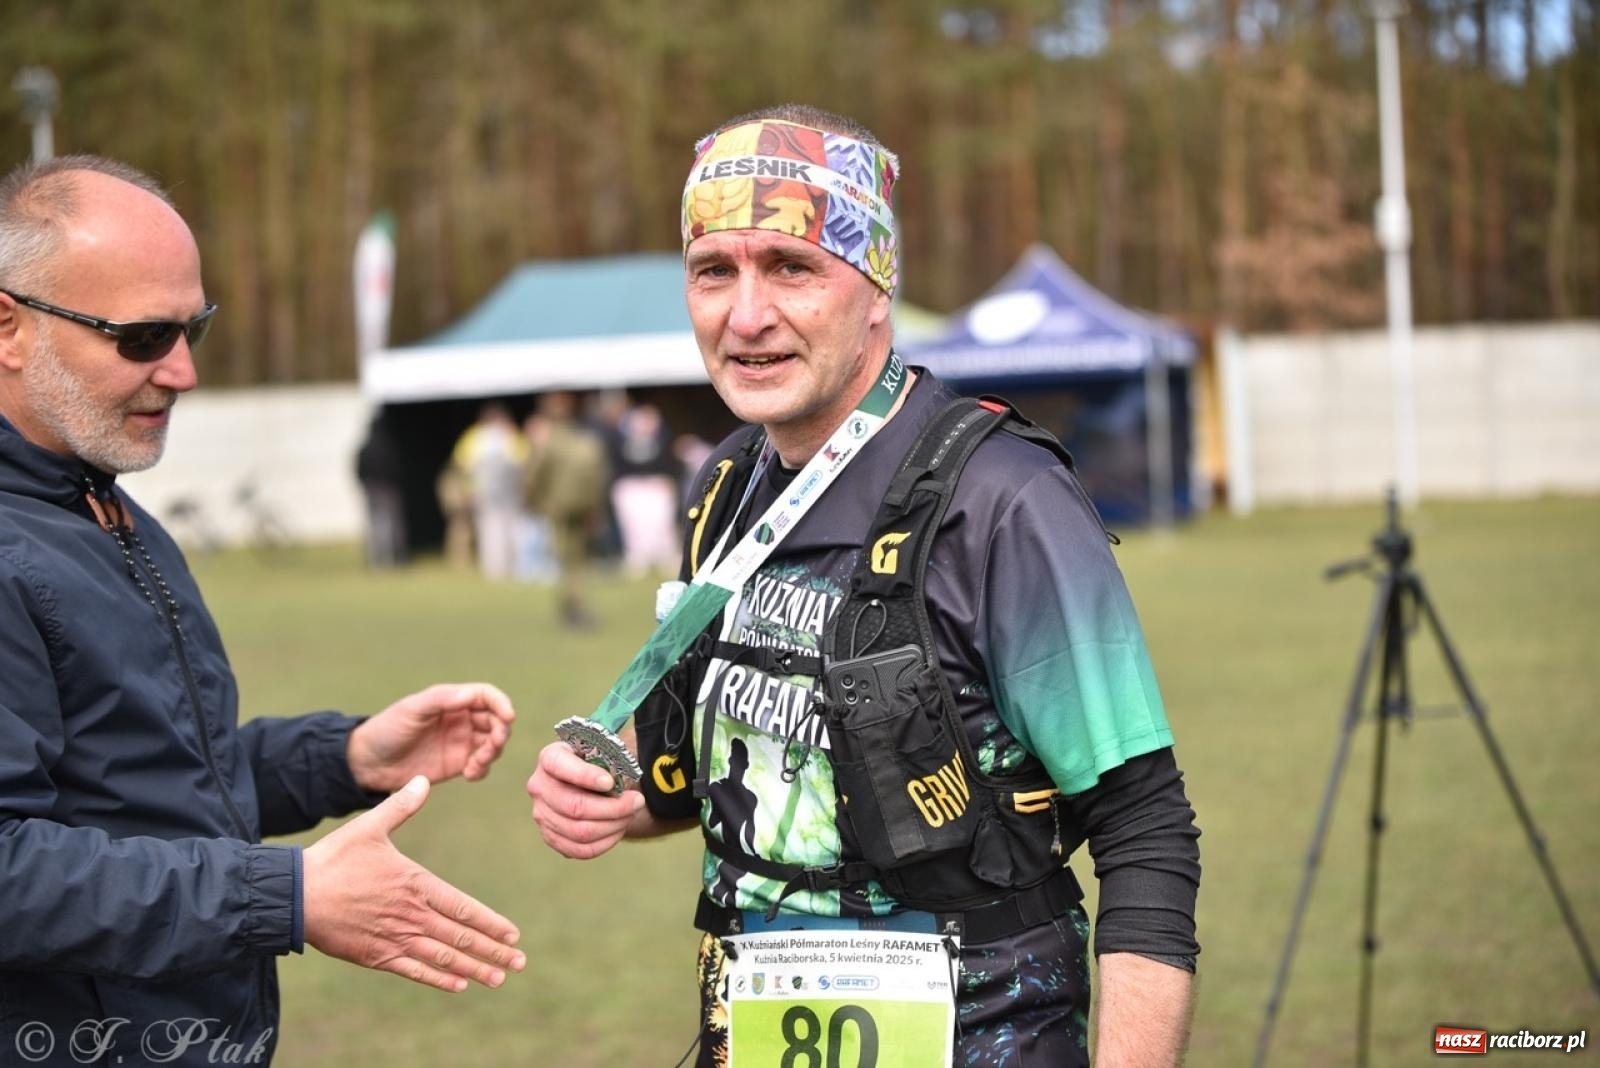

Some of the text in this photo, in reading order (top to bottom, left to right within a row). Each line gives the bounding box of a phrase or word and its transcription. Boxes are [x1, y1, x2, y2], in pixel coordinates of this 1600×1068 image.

[747, 938, 789, 951] Kuźniański
[790, 938, 848, 950] Półmaraton
[850, 938, 881, 951] Leśny
[882, 938, 941, 953] RAFAMET
[754, 952, 923, 966] Kuźnia Raciborska, 5 kwietnia 2025 r.
[780, 1004, 880, 1068] 80
